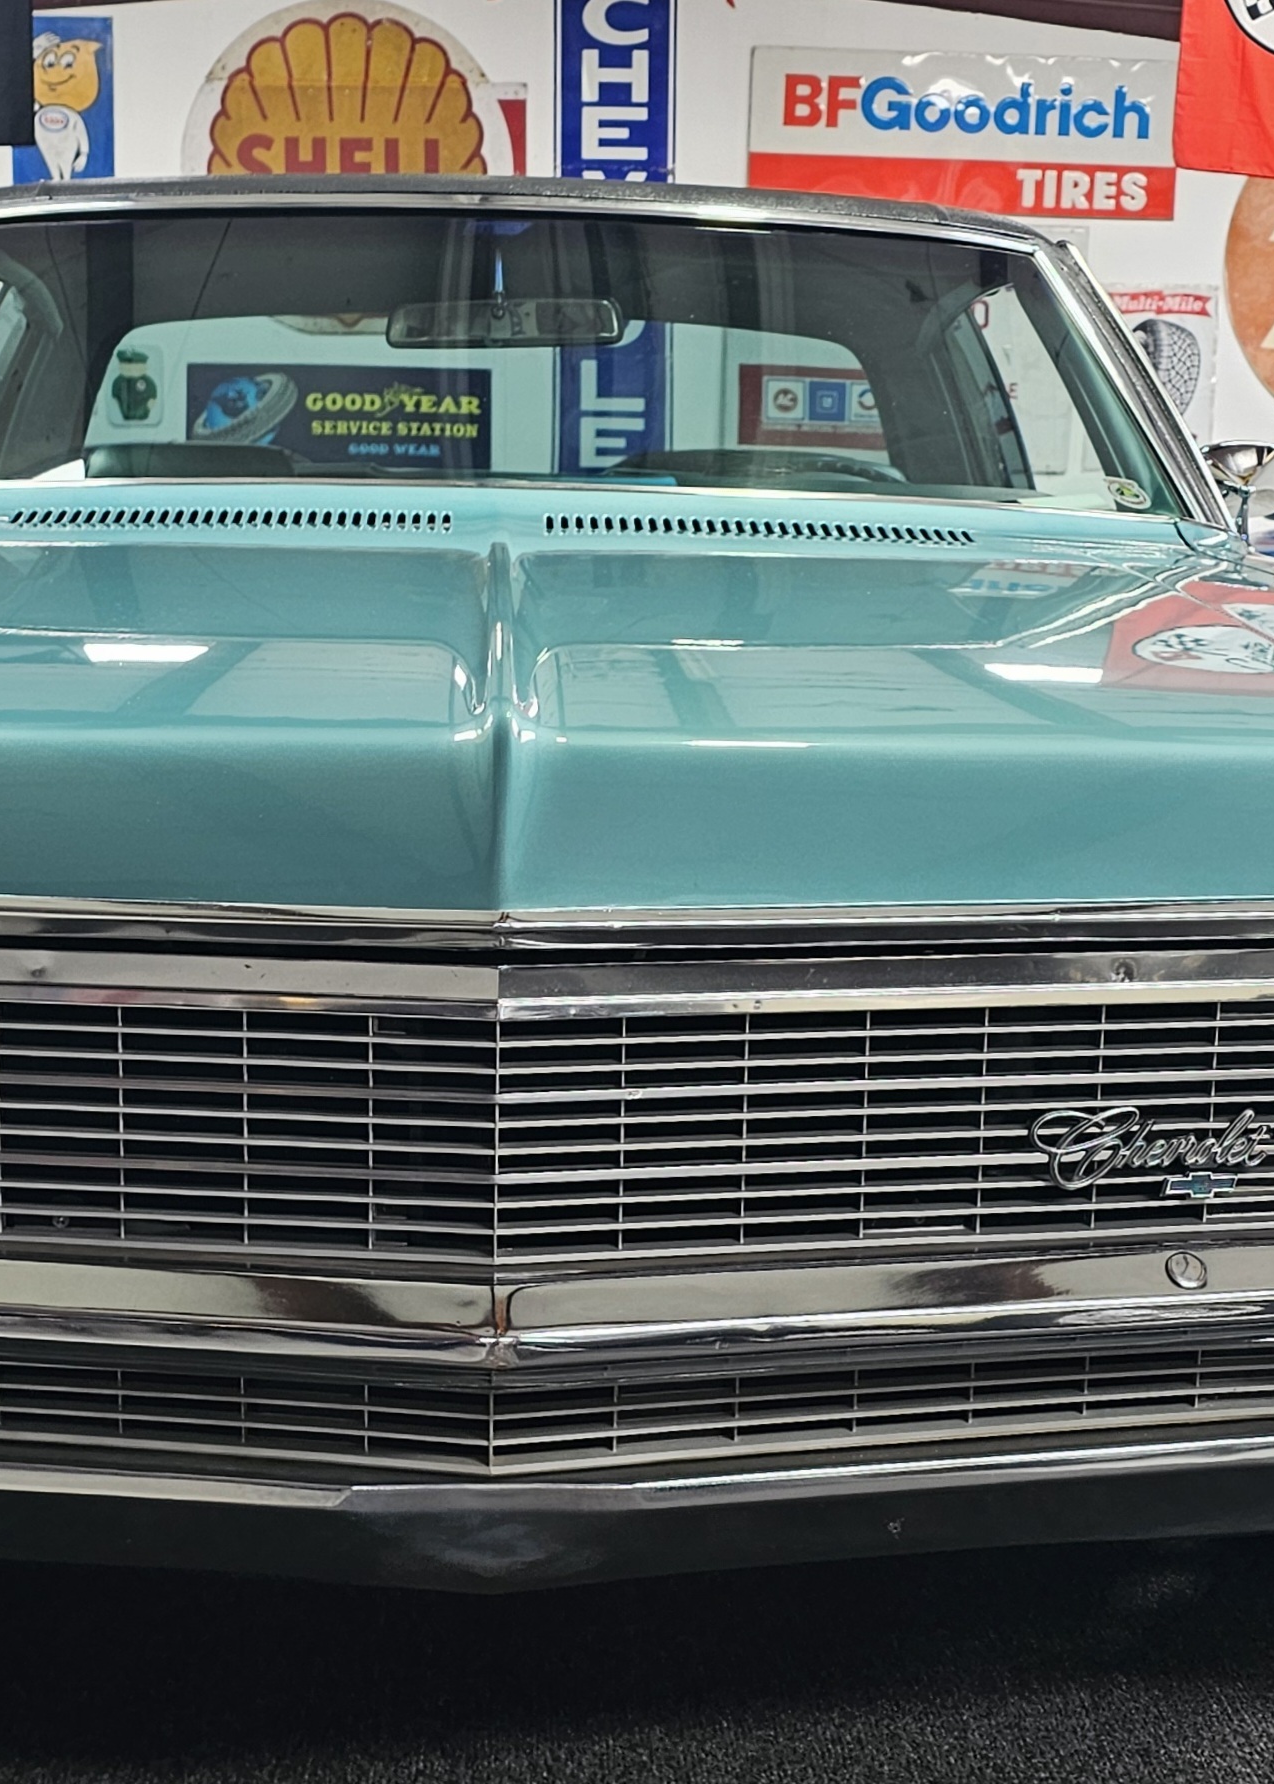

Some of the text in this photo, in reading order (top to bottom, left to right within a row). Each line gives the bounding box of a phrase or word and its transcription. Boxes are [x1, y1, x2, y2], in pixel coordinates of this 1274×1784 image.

[783, 74, 1149, 139] BFGoodrich
[1016, 169, 1148, 211] TIRES
[311, 420, 479, 438] SERVICE STATION
[348, 443, 440, 457] GOOD WEAR
[1029, 1106, 1273, 1190] Chevrolet
